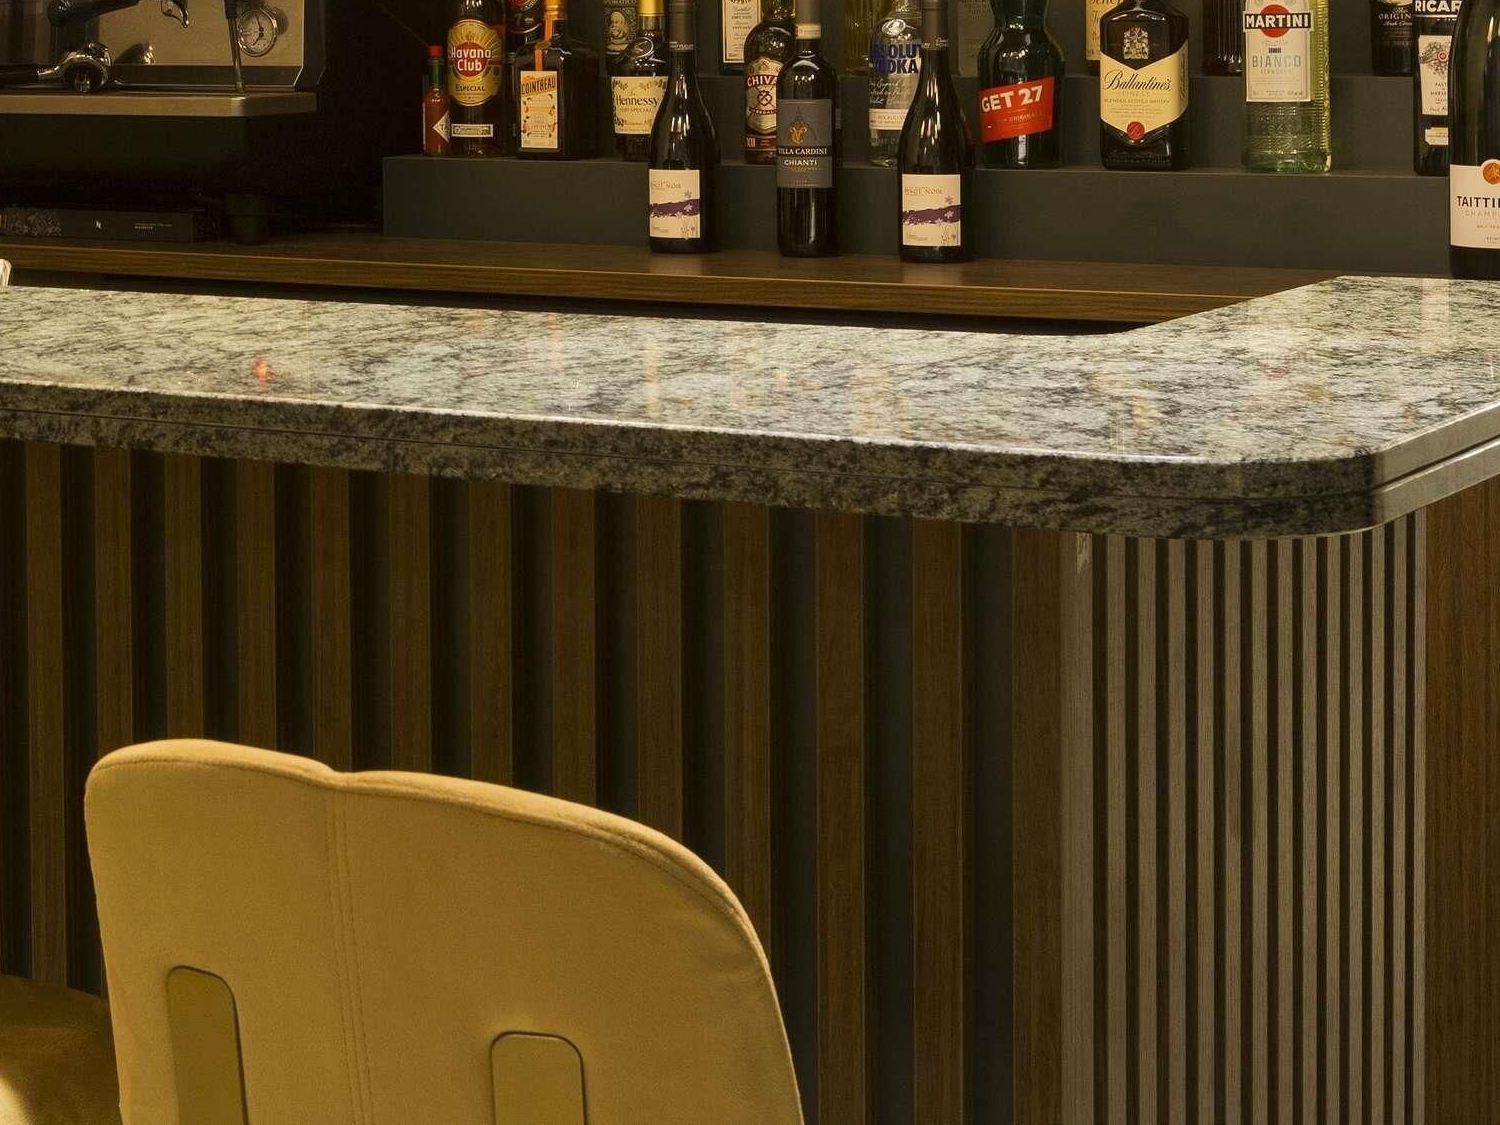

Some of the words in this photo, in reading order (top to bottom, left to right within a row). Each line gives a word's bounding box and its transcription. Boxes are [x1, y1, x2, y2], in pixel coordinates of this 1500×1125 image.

[1414, 0, 1463, 13] RICAR
[1245, 14, 1309, 28] MARTINI
[451, 47, 492, 60] Havana
[457, 59, 483, 72] Club
[1252, 55, 1301, 69] BIANCO
[521, 76, 556, 95] COINTREAU
[615, 94, 659, 108] Hennessy
[981, 89, 1015, 112] GET
[1018, 85, 1044, 106] 27
[795, 147, 828, 156] CARDINI
